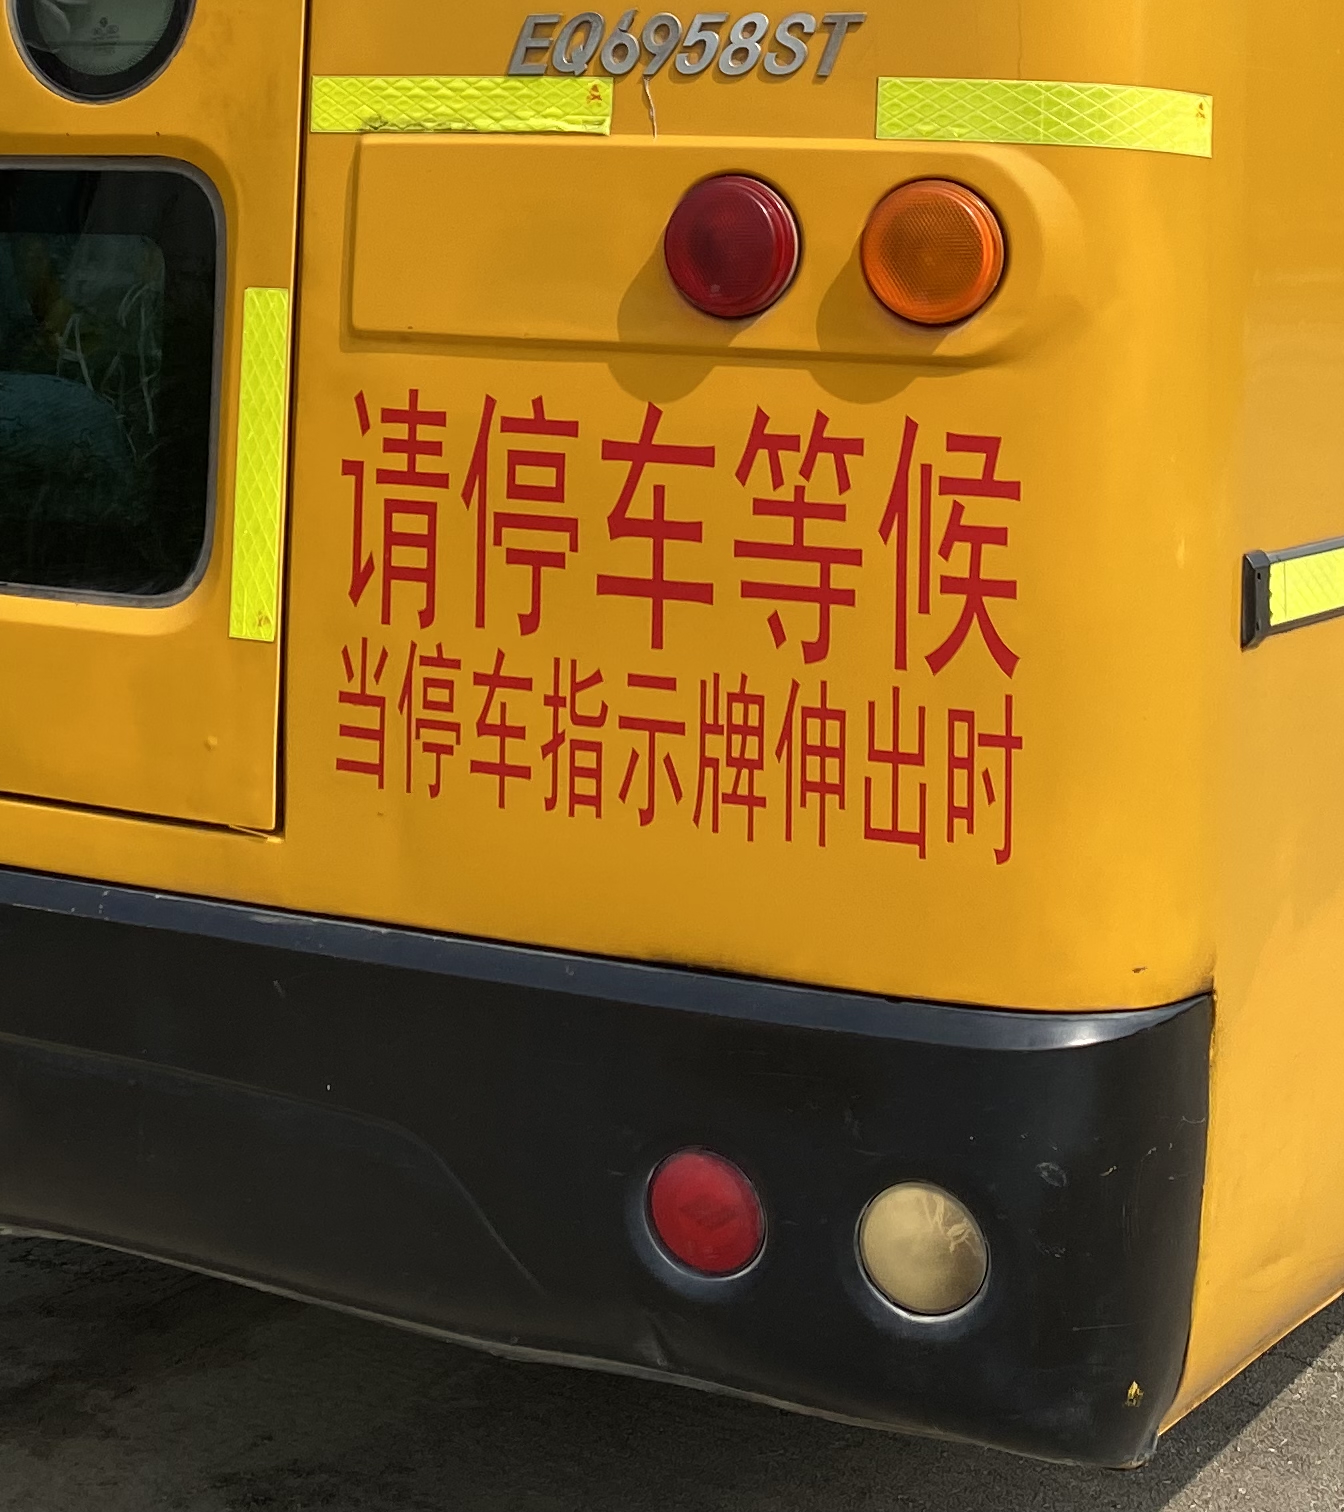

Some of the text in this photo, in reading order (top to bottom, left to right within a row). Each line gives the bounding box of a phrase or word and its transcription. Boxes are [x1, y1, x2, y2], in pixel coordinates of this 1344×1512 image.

[508, 8, 867, 77] EQ6958ST
[341, 388, 1023, 679] 请停车等候
[335, 636, 1024, 866] 当停车指示牌伸出时
